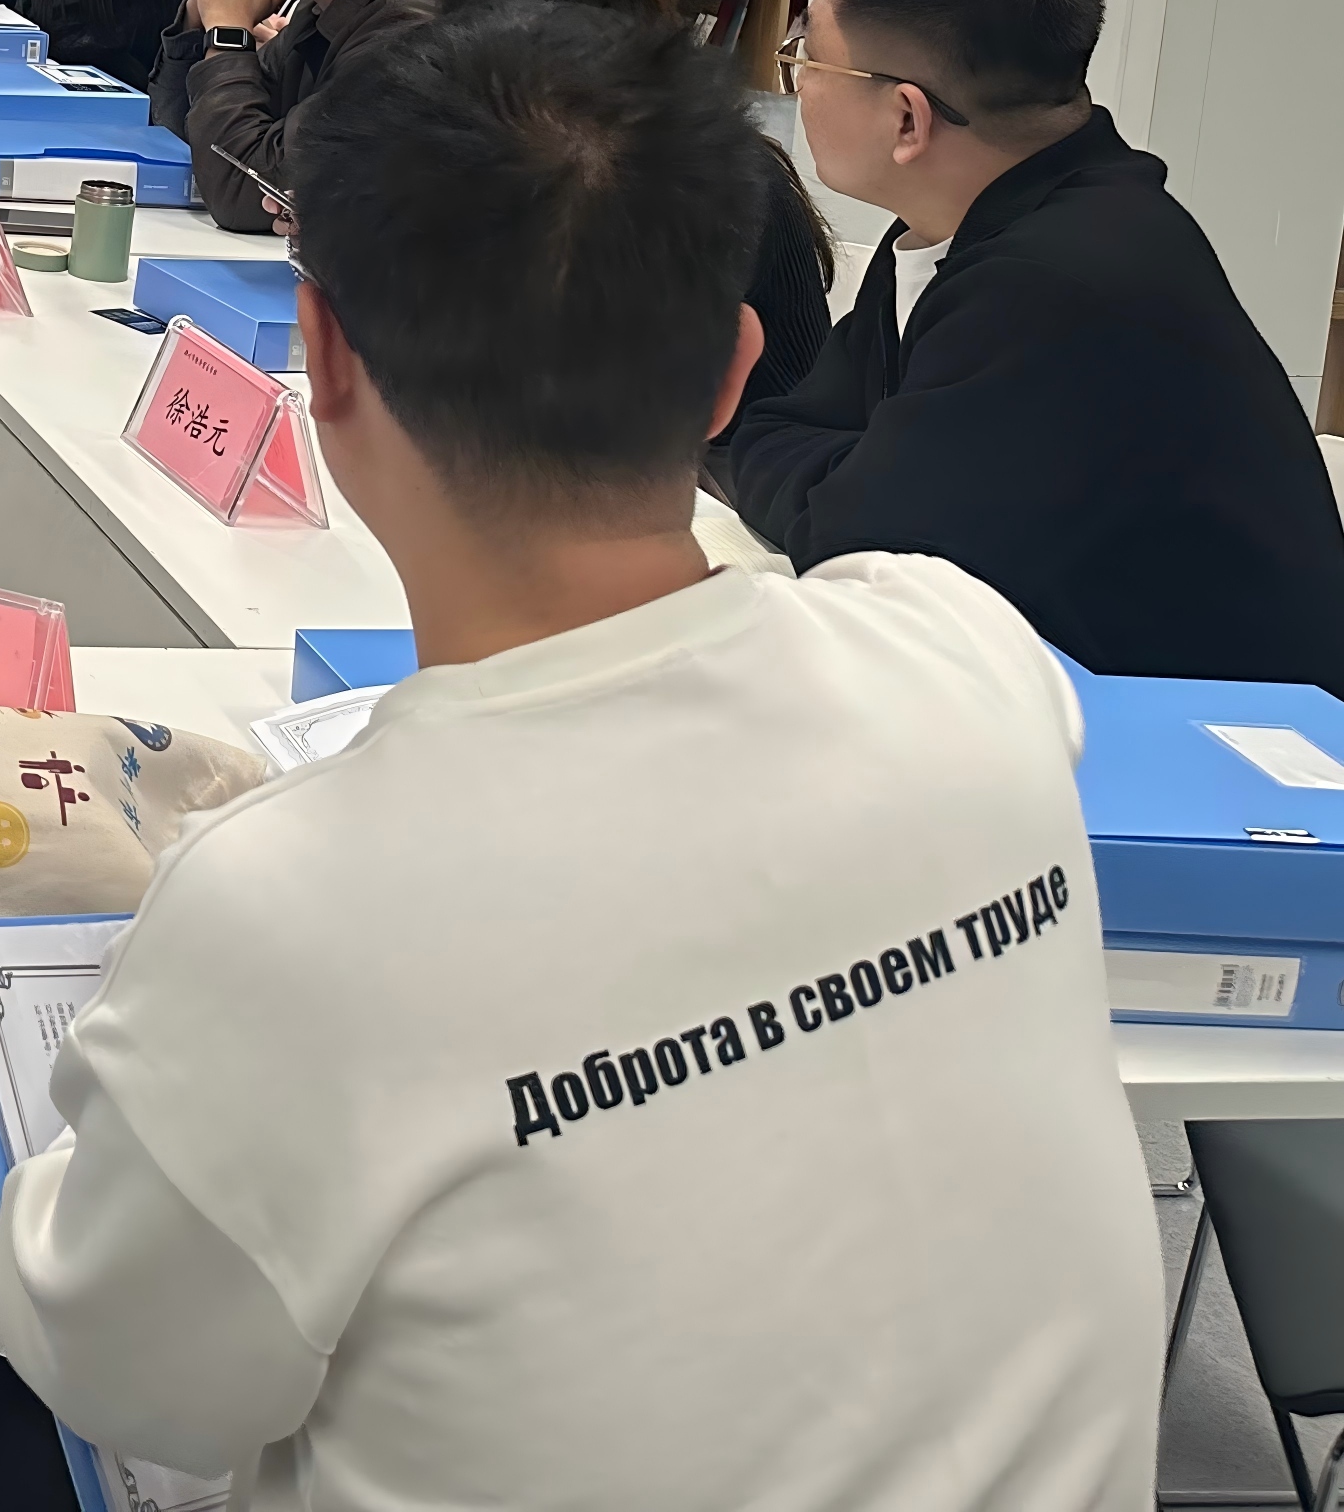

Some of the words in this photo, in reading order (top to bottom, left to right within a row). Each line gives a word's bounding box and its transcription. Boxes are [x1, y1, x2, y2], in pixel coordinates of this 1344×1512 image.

[165, 387, 230, 457] 徐浩元
[505, 1016, 746, 1148] Доброта
[747, 999, 786, 1052] в
[789, 928, 957, 1035] своем
[955, 862, 1071, 964] труде
